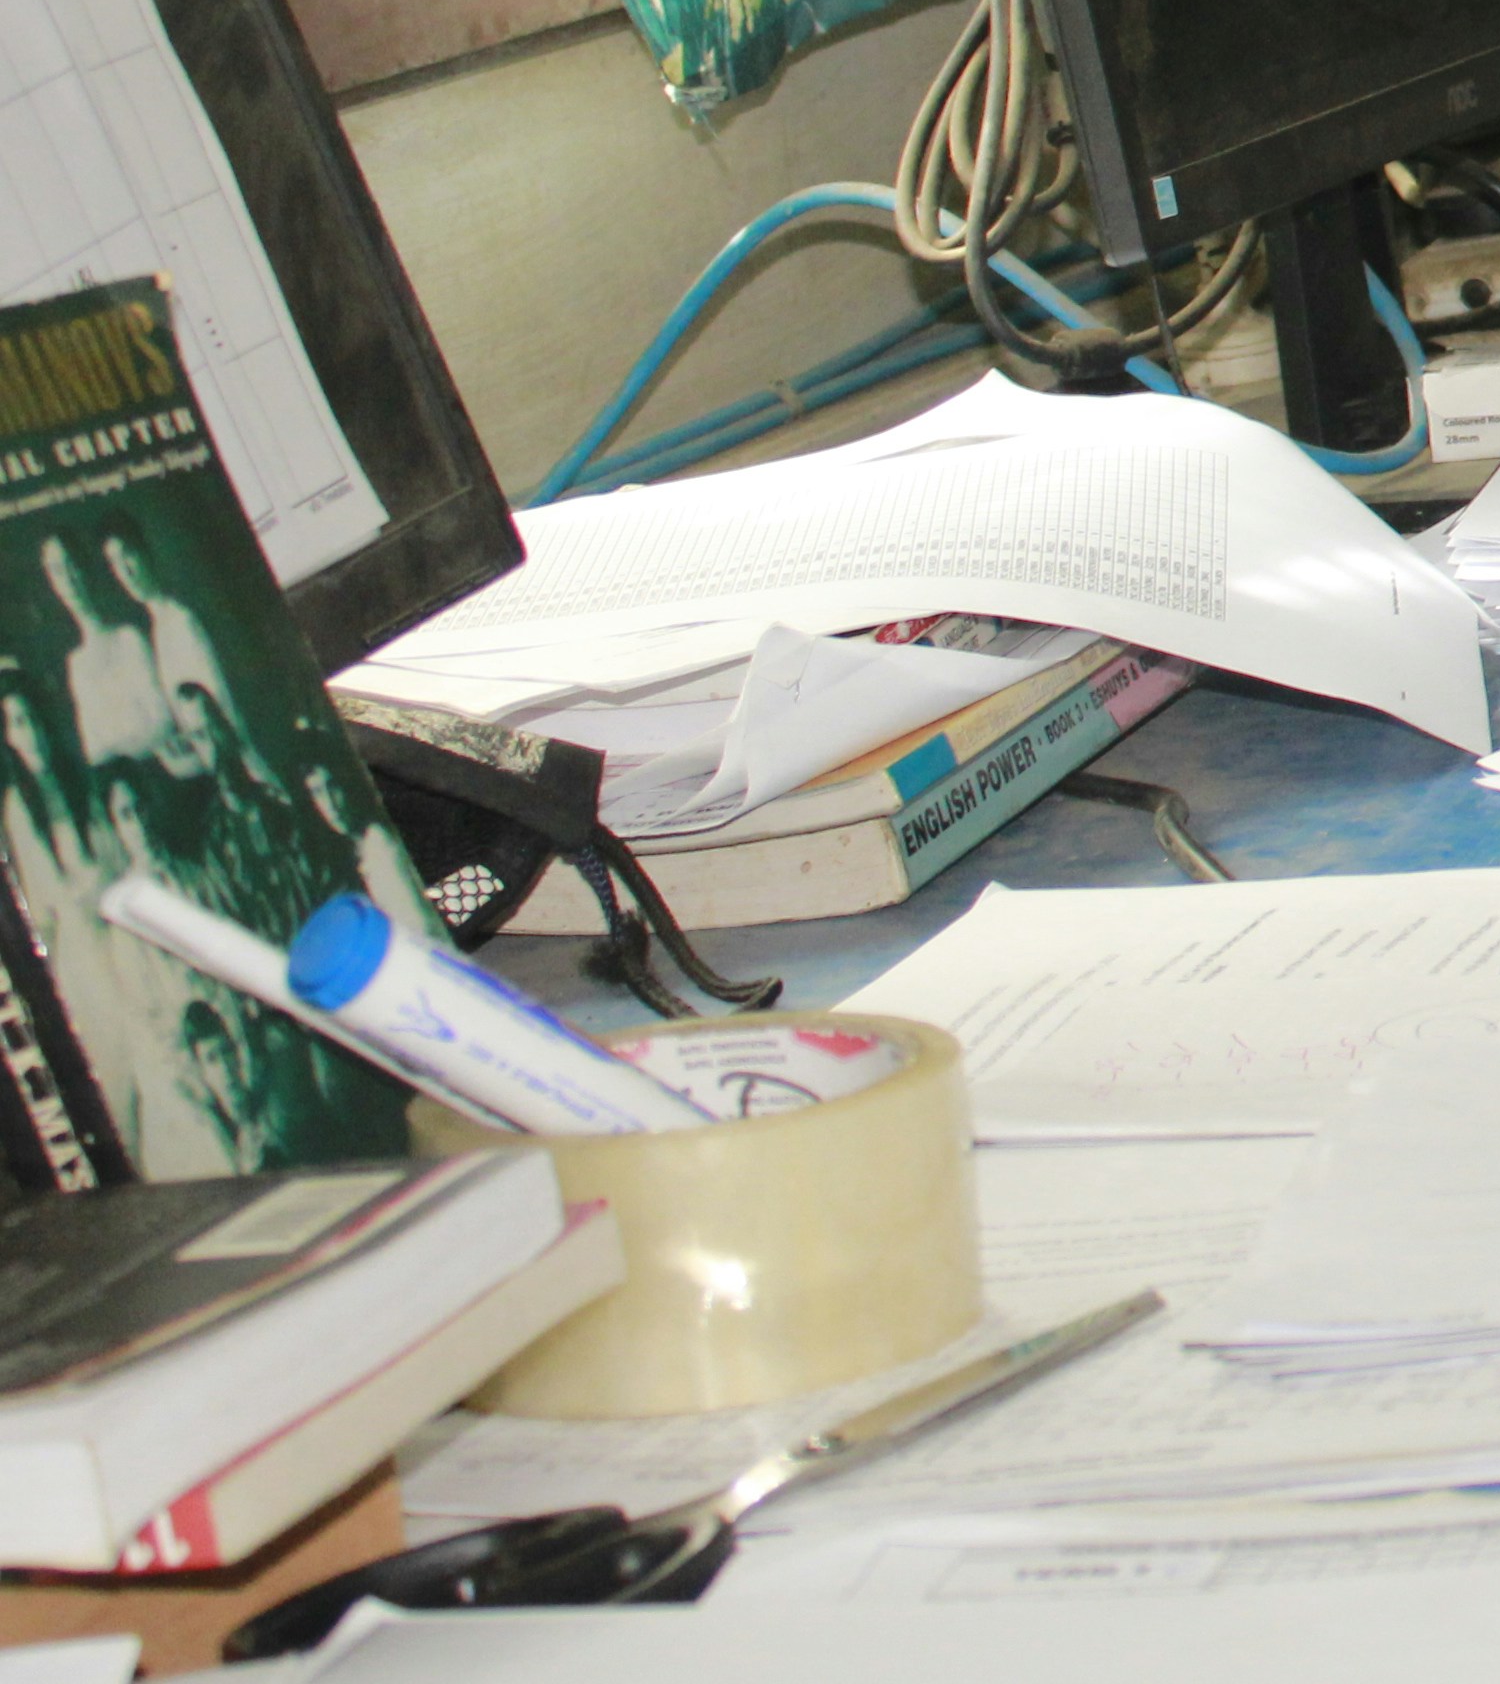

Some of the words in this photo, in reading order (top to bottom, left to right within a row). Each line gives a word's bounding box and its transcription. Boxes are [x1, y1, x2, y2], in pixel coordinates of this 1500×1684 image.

[53, 407, 196, 467] CHAPTER
[1443, 417, 1486, 427] Coloured
[1445, 435, 1480, 445] 28mm
[901, 781, 977, 857] ENGLISH
[975, 736, 1038, 801] POWER
[1044, 708, 1076, 744] BOOK
